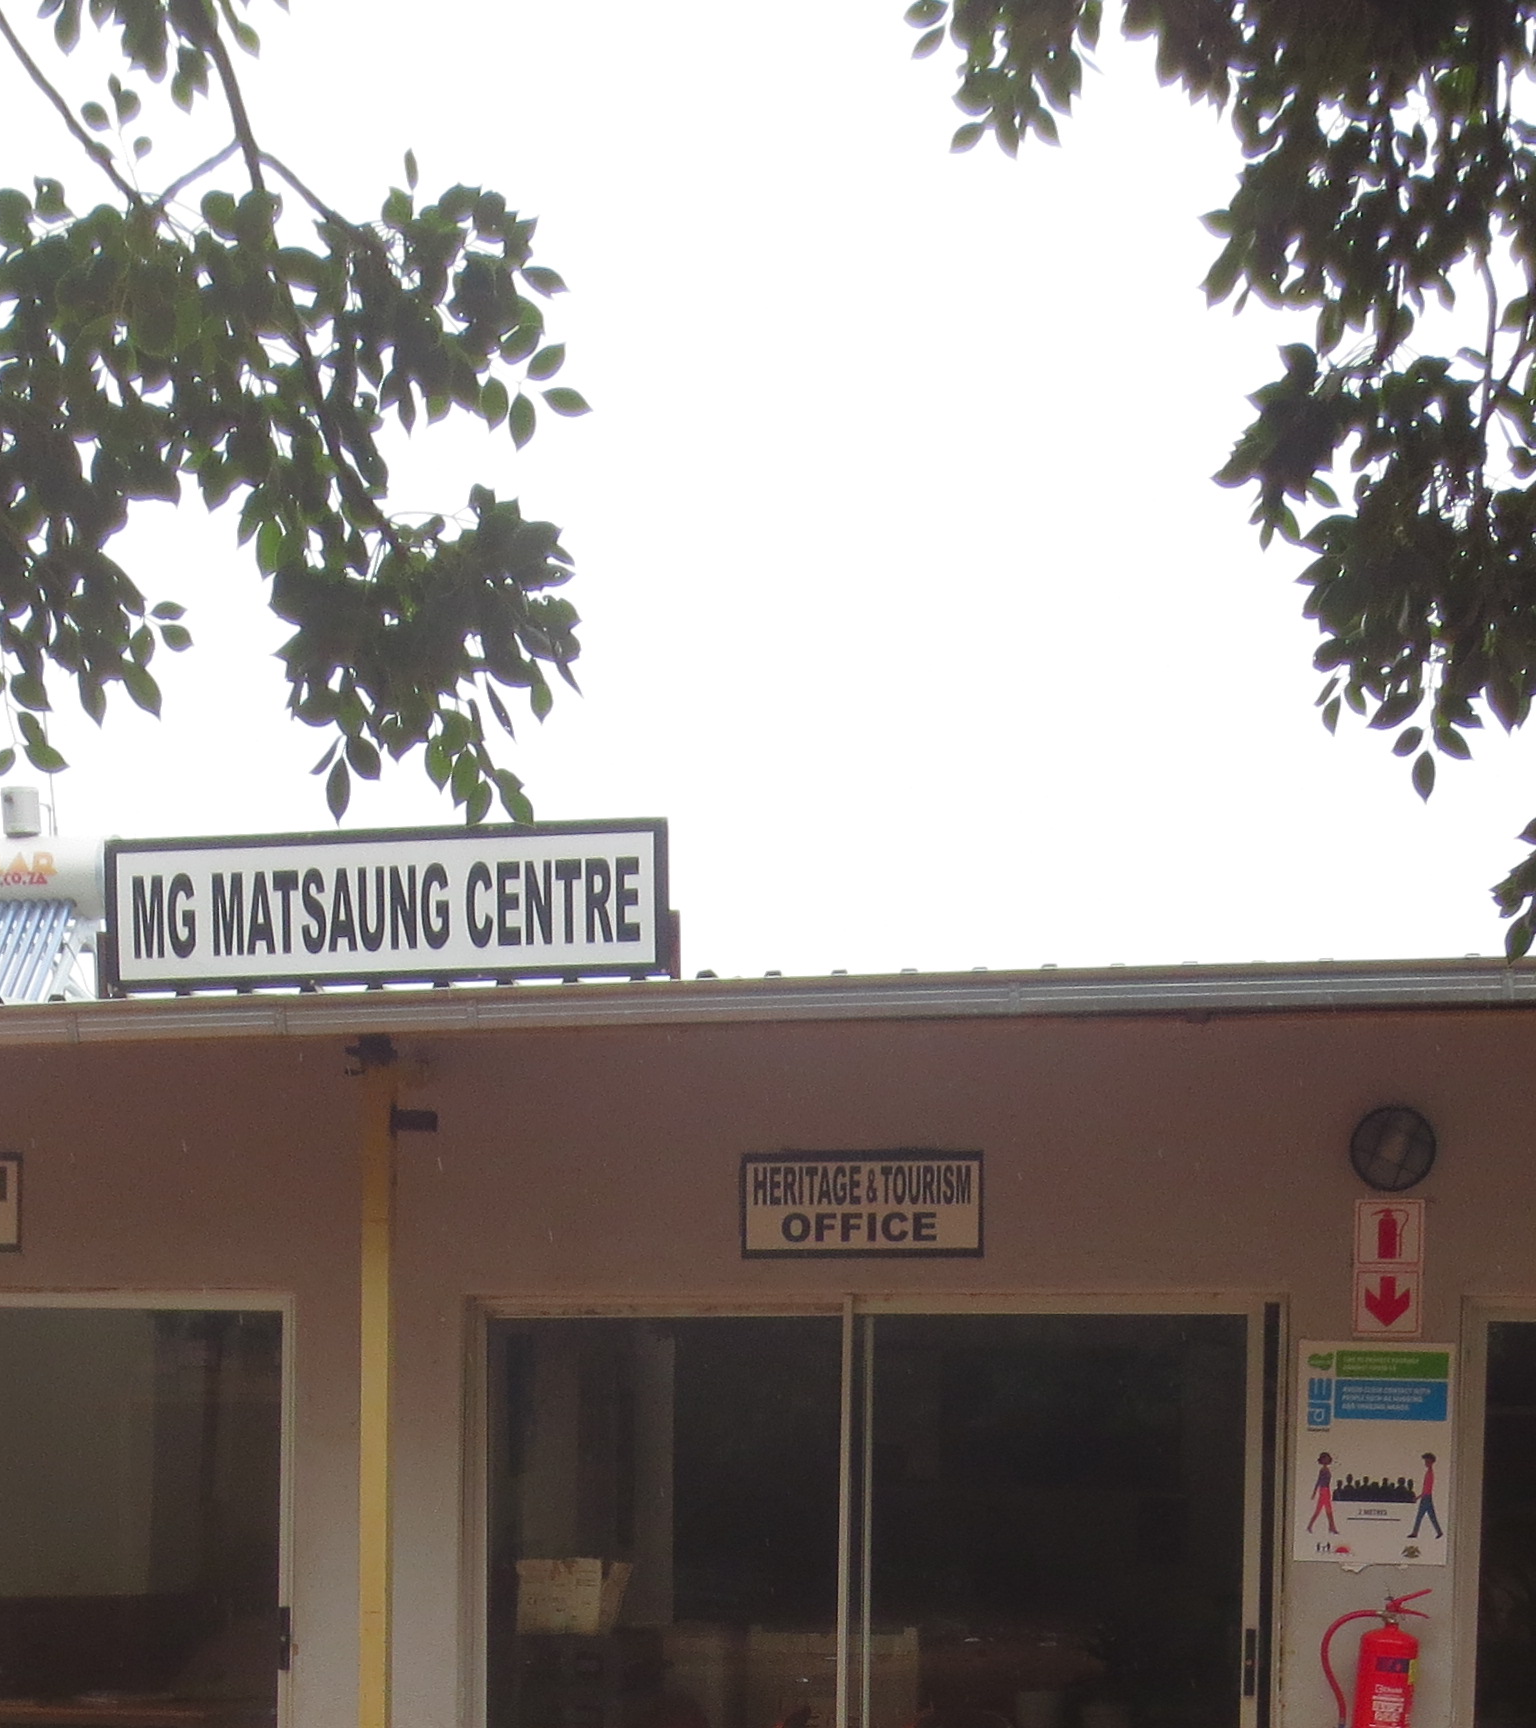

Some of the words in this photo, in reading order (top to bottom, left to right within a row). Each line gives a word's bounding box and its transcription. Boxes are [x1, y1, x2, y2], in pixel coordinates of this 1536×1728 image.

[131, 872, 197, 959] MG
[211, 862, 451, 956] MATSAUNG
[466, 856, 642, 949] CENTRE
[753, 1165, 862, 1206] HERITAGE
[866, 1168, 877, 1203] &
[881, 1164, 972, 1205] TOURISM
[781, 1211, 938, 1242] OFFICE
